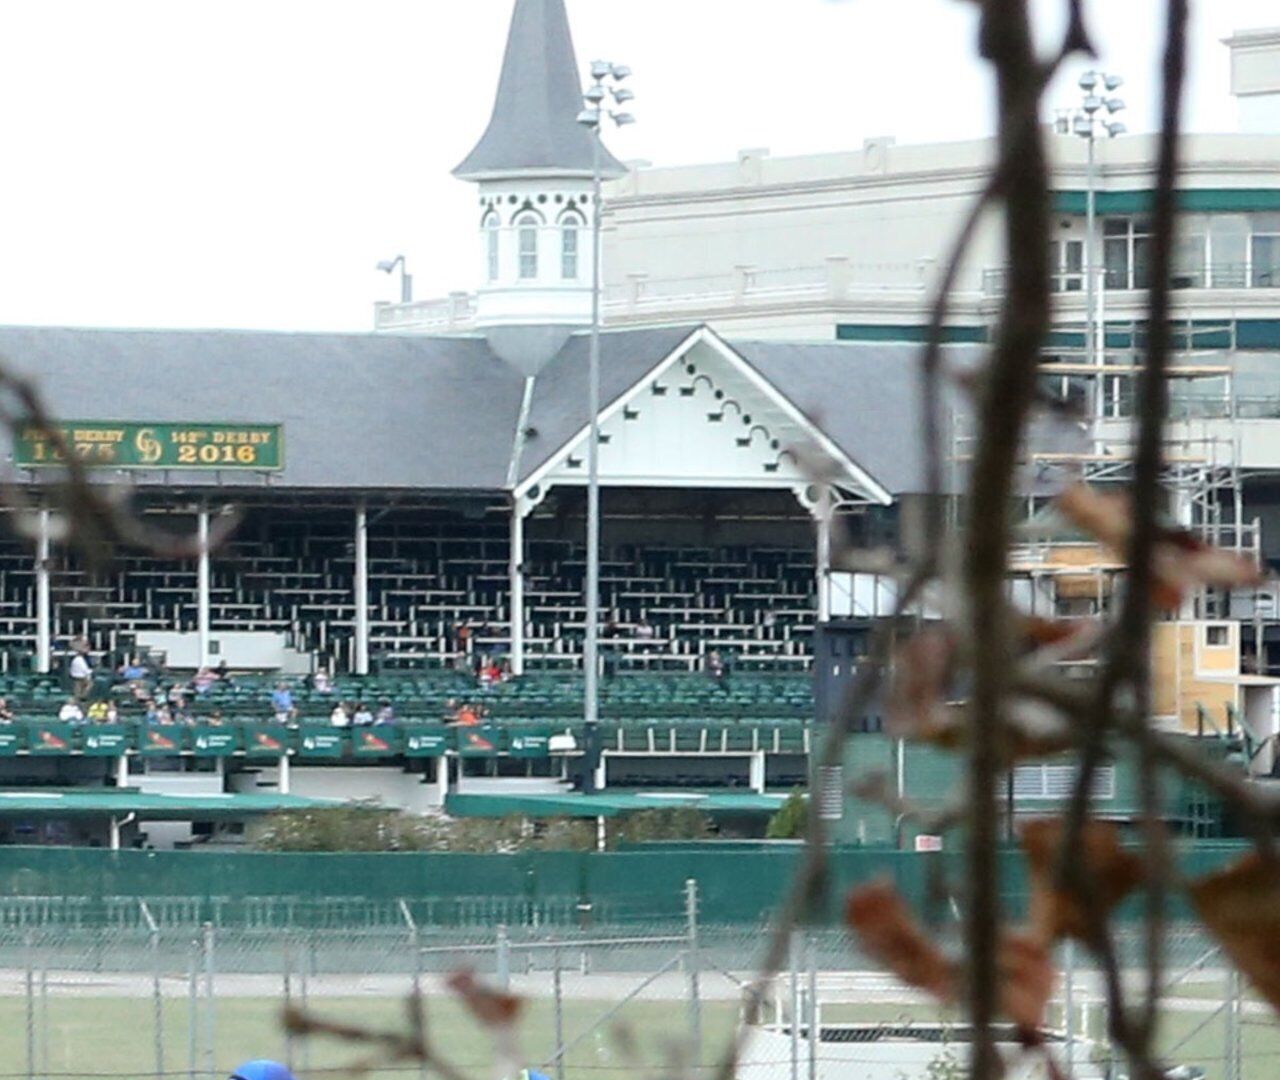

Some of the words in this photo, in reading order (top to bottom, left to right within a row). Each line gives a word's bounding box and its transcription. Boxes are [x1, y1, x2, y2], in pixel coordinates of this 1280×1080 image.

[212, 431, 271, 443] DERBY
[33, 443, 115, 460] 175
[177, 444, 256, 463] 2016
